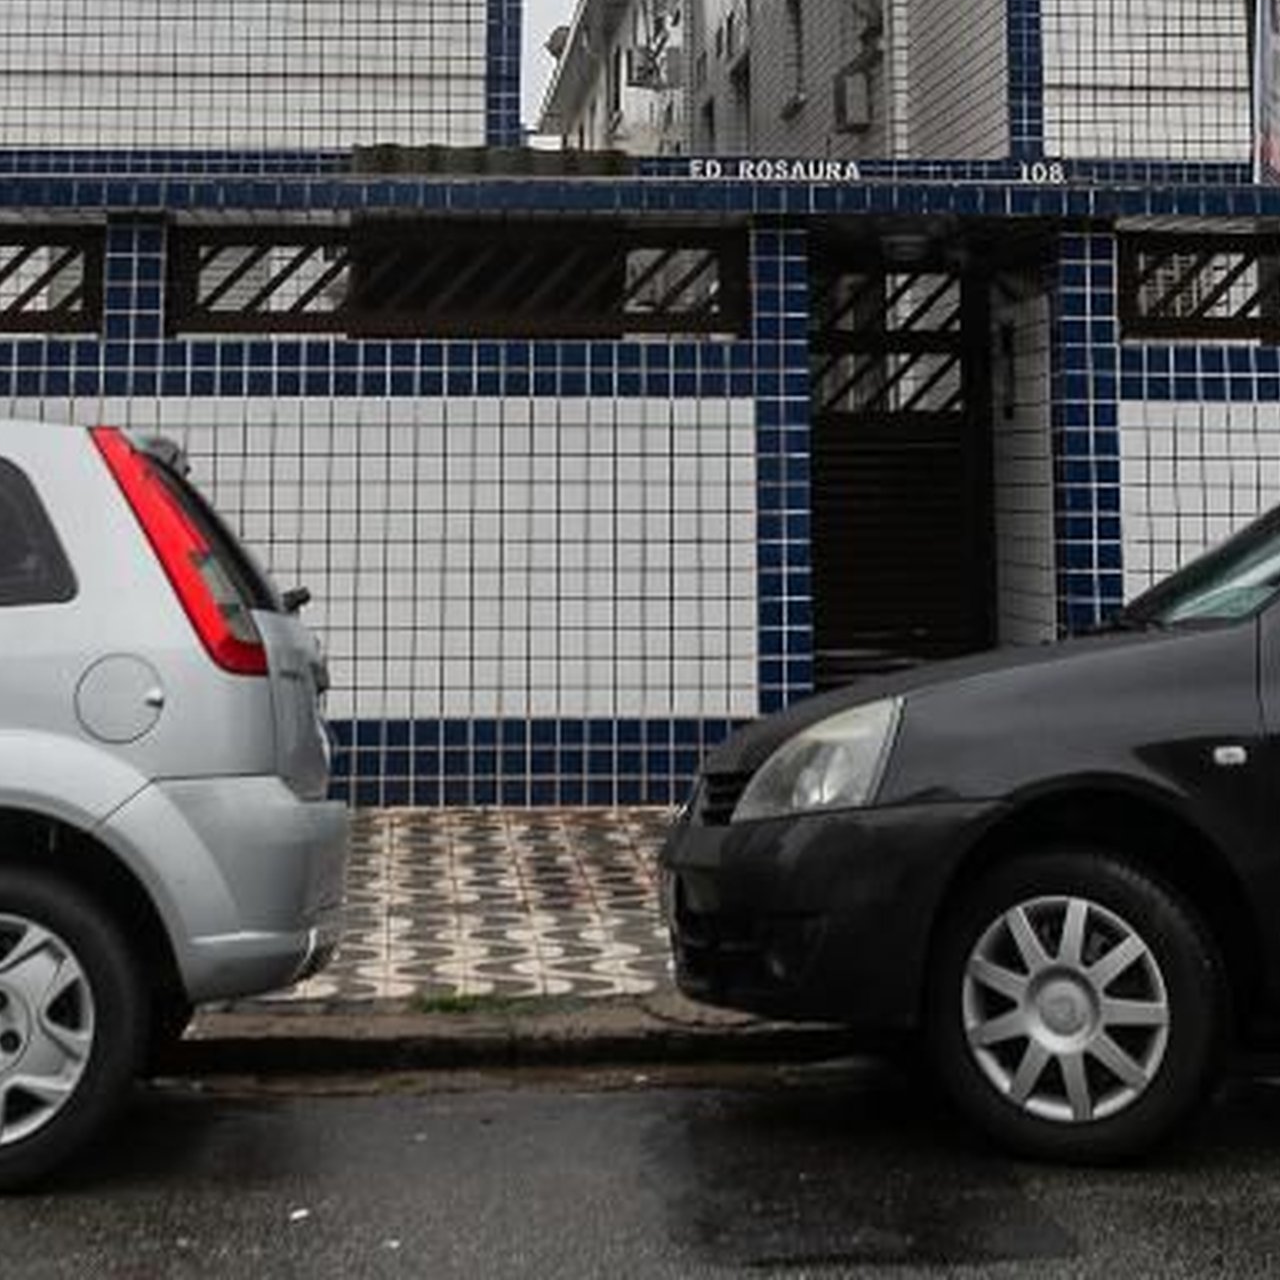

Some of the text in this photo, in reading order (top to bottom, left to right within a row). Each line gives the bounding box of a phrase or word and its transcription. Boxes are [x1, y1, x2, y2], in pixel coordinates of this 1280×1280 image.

[689, 159, 860, 181] ED ROSAURA
[1020, 161, 1064, 184] 108
